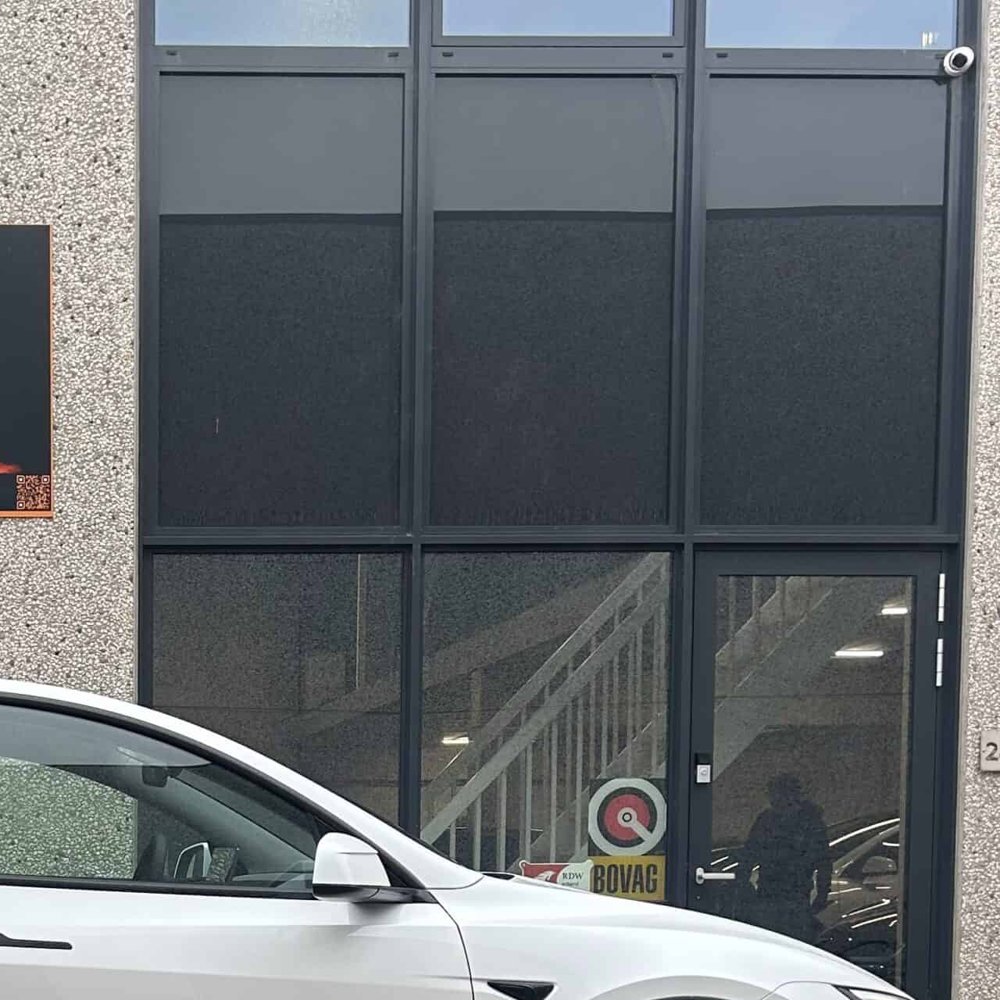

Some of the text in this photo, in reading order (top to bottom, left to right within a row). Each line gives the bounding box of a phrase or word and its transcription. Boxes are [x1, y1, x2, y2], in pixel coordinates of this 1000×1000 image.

[985, 742, 1000, 761] 2
[562, 872, 585, 880] RDW
[593, 864, 658, 893] BOVAG
